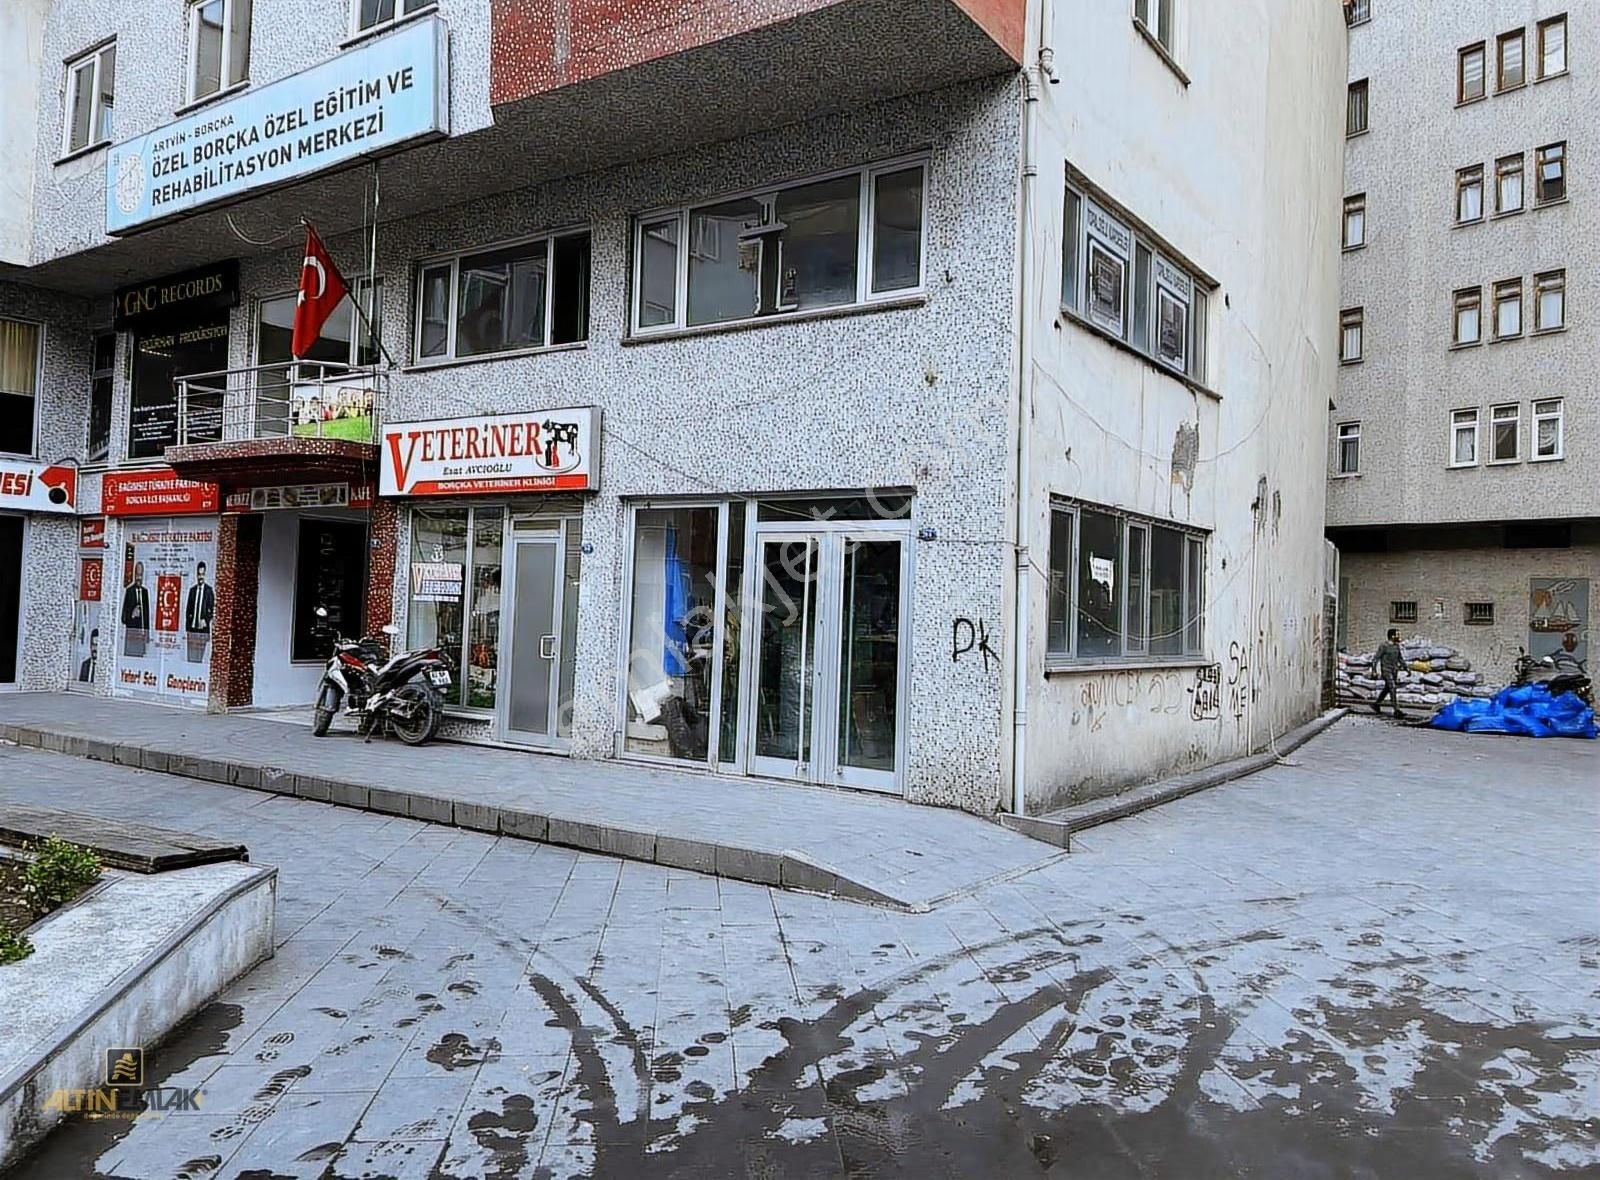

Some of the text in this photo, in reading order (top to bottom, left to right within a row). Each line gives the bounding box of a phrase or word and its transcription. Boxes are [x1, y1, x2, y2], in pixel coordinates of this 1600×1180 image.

[152, 154, 189, 179] ÖZEL
[193, 125, 260, 164] BORÇKA
[264, 108, 308, 139] ÖZEL
[314, 79, 381, 122] EĞİTİM
[387, 66, 413, 94] VE
[153, 131, 186, 154] ARTVİN
[194, 115, 234, 138] BORÇKA
[152, 105, 384, 206] REHABİLİTASYON MERKEZİ
[160, 273, 222, 304] RECORDS
[0, 469, 33, 497] ESİ
